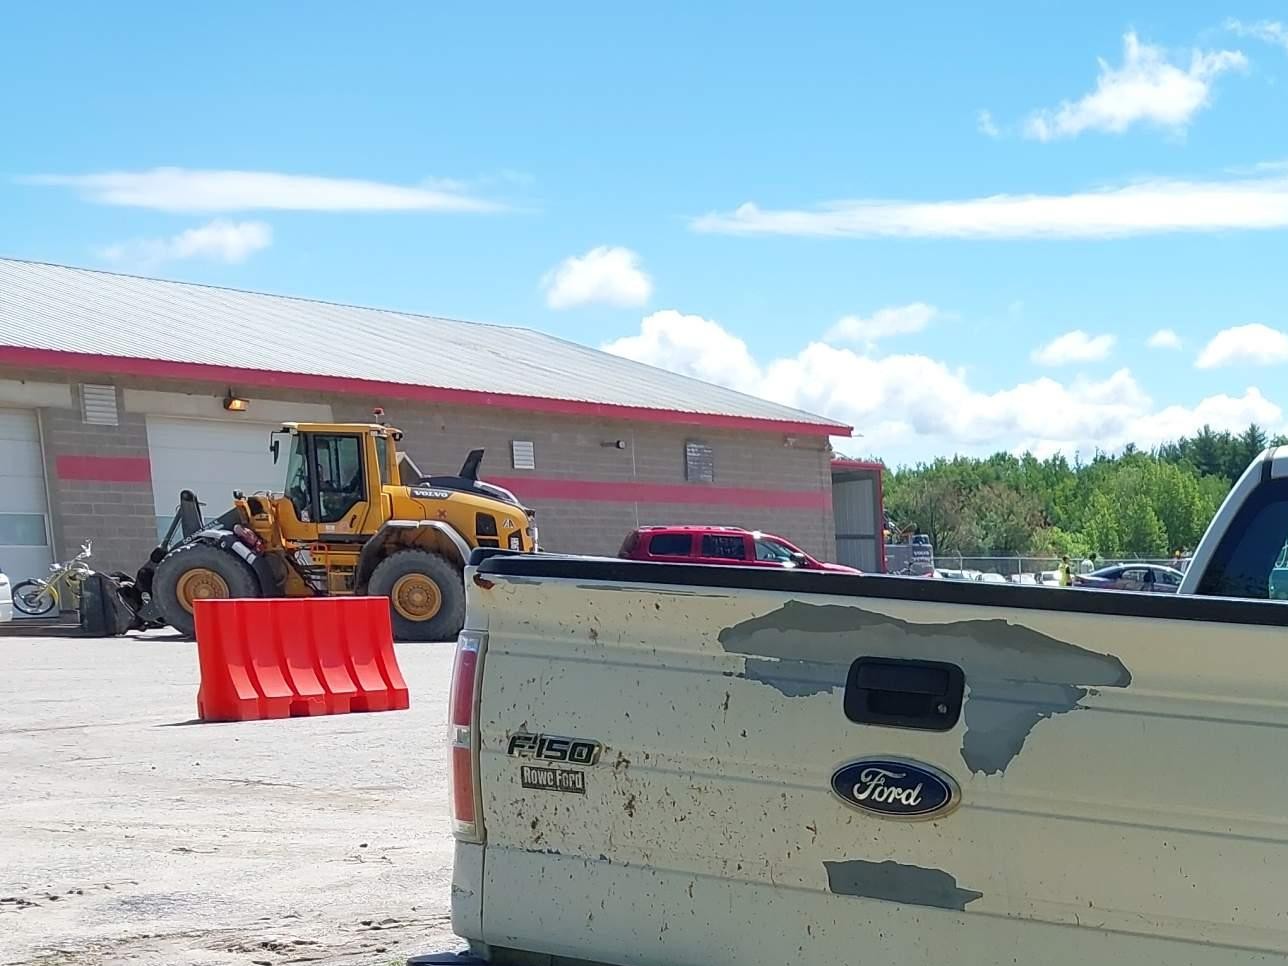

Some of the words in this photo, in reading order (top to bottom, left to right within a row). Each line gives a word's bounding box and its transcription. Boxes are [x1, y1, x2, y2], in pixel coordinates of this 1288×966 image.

[413, 490, 449, 498] VOLVO
[507, 732, 596, 765] F-150
[555, 768, 584, 790] Ford
[852, 767, 922, 806] Ford
